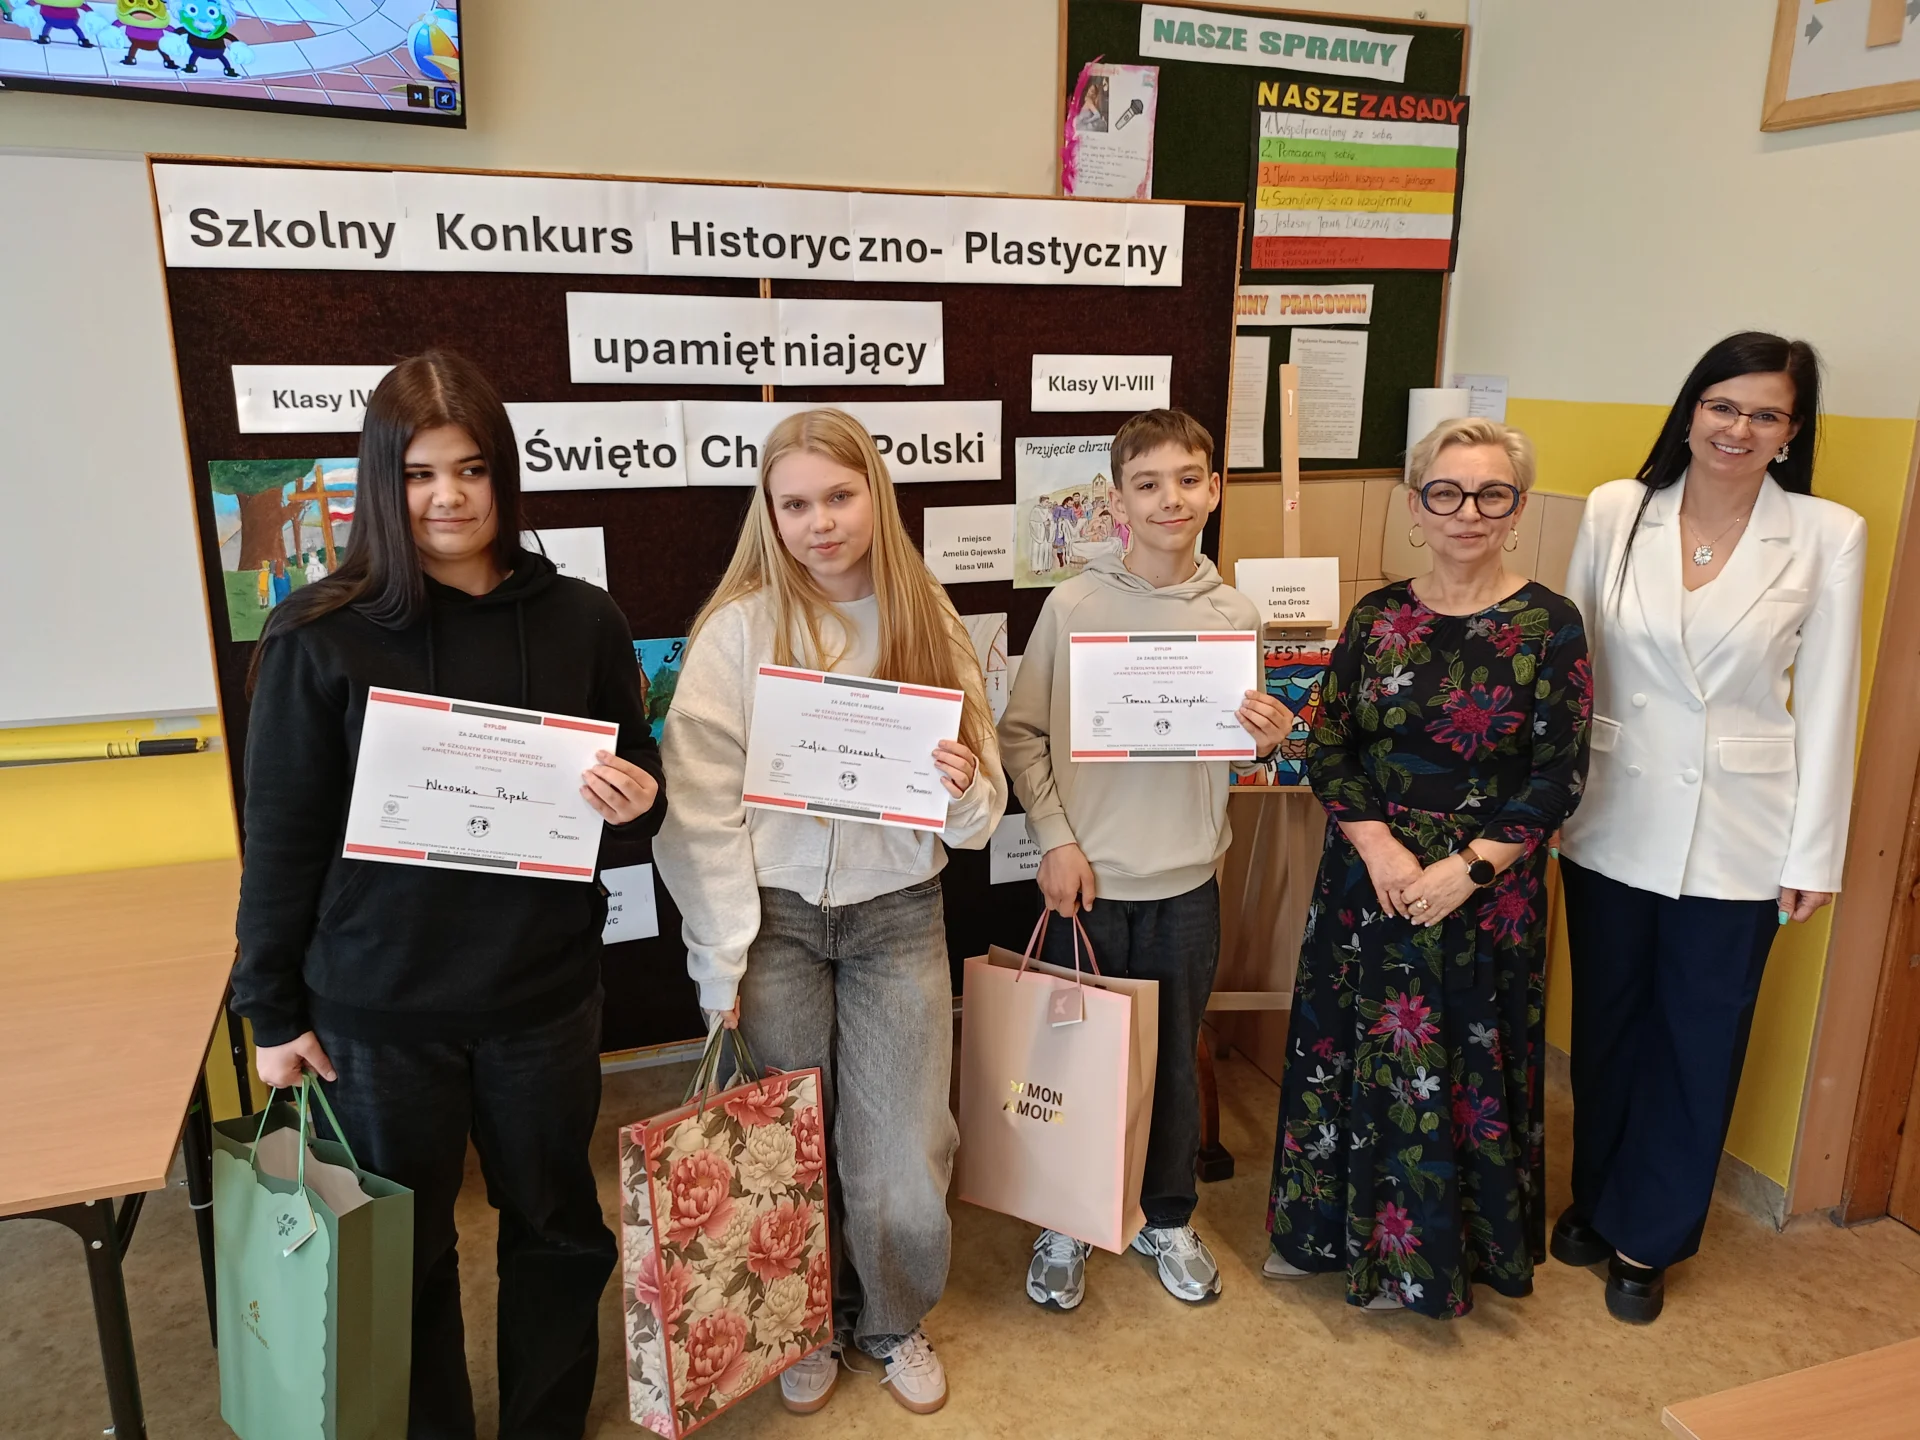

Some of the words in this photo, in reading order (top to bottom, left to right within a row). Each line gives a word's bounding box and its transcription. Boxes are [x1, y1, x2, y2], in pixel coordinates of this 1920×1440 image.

[1153, 18, 1248, 52] NASZE
[1258, 31, 1398, 67] SPRAWY
[1257, 81, 1358, 116] NASZE
[1359, 94, 1466, 125] ZASADY
[188, 207, 396, 260] Szkolny
[436, 213, 634, 255] Konkurs
[965, 231, 1168, 276] Plastyczny
[1280, 294, 1367, 315] PRACOWNI
[593, 331, 927, 375] upamiętniający
[1049, 375, 1098, 395] Klasy
[1102, 375, 1154, 391] VI-VIII
[272, 389, 343, 413] Klasy
[525, 428, 677, 478] Święto
[871, 432, 985, 466] Polski
[1025, 442, 1076, 459] Przyjęcie
[961, 535, 992, 544] miejsce
[942, 549, 969, 558] Amelia
[970, 548, 1006, 557] Gajewska
[955, 563, 976, 571] klasa
[1276, 585, 1306, 594] miejsce
[1288, 598, 1310, 606] Grosz
[1295, 611, 1306, 619] VA
[1263, 644, 1306, 661] ZEST
[500, 737, 526, 746] MIEJSCA
[798, 739, 827, 753] Zofia
[838, 744, 886, 759] Olszewska
[447, 742, 481, 752] SZKOLNYM
[482, 747, 517, 758] KONKURSIE
[519, 752, 543, 761] WIEDZY
[534, 761, 557, 769] POLSKI
[425, 778, 479, 795] Weronika
[1007, 849, 1032, 859] Kacper
[1019, 862, 1039, 870] klasa
[1027, 1082, 1063, 1107] MON
[1002, 1097, 1066, 1127] AMOUR
